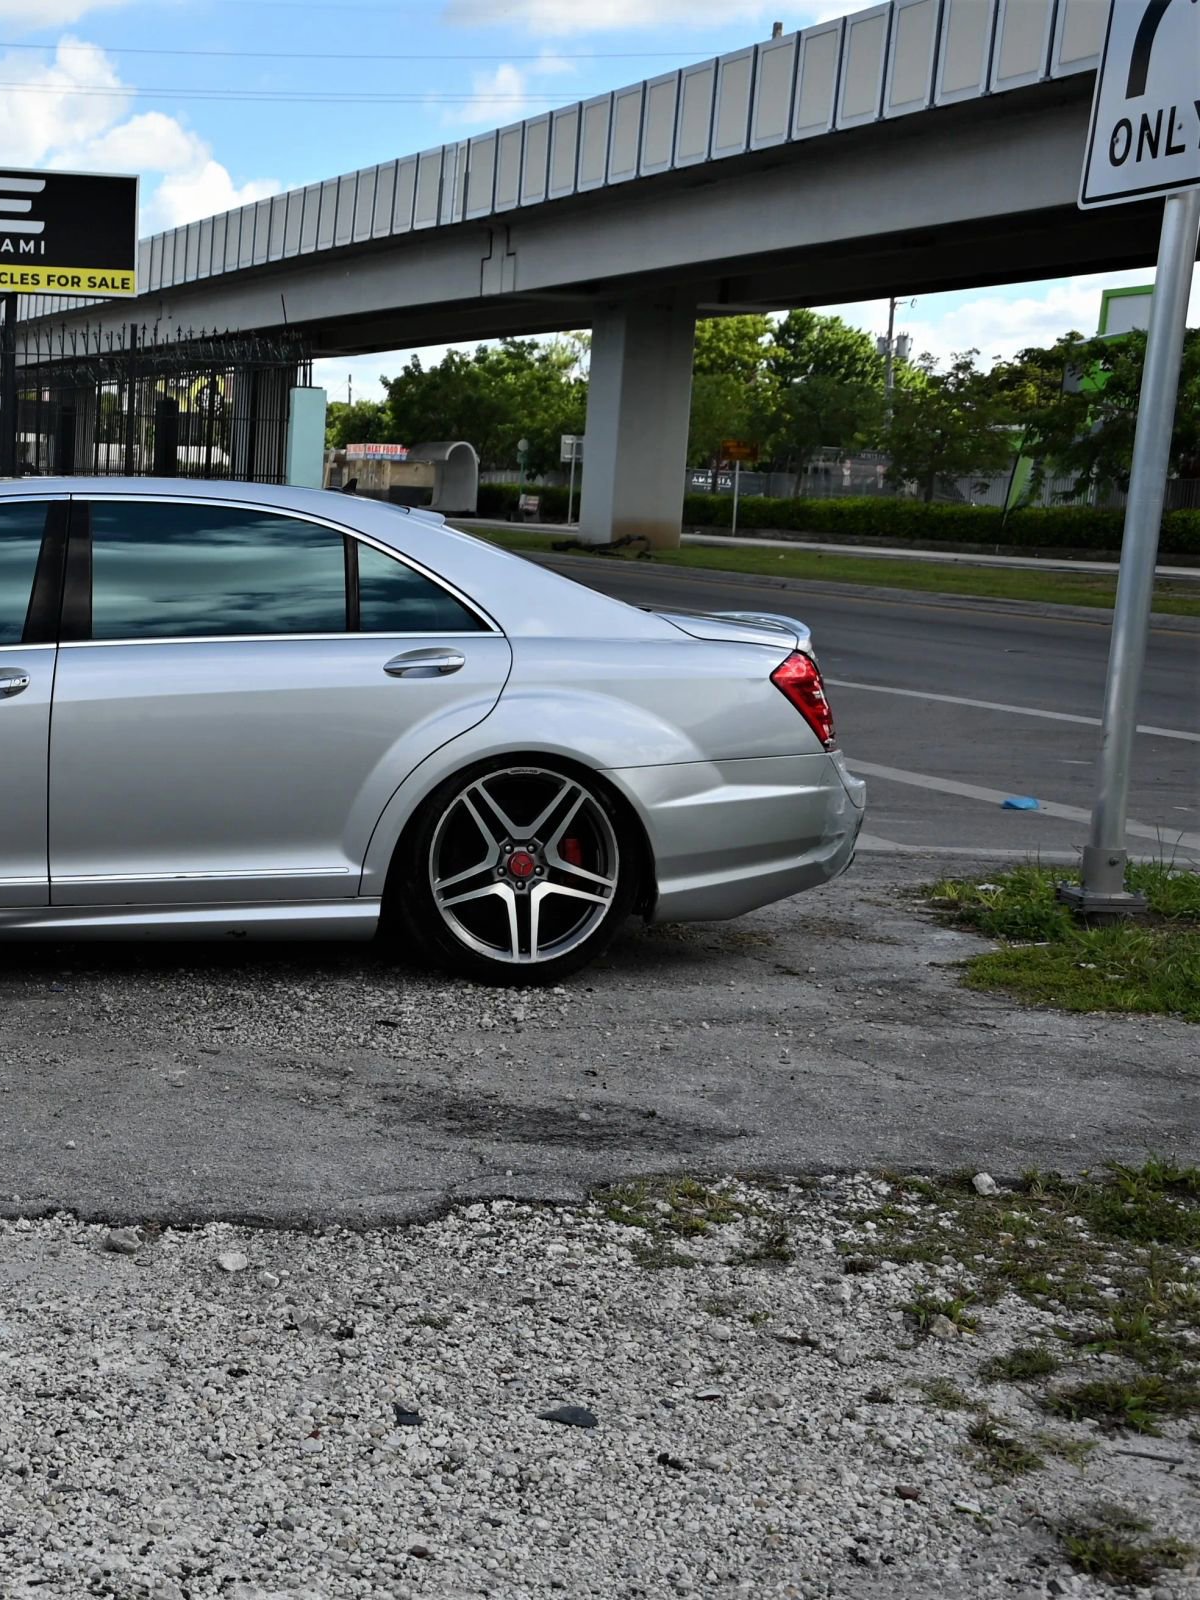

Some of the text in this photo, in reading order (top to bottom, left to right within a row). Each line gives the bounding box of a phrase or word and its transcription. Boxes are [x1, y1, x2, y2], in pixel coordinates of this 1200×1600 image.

[1109, 100, 1200, 168] ONL
[46, 274, 82, 288] FOR
[87, 276, 131, 290] SALE
